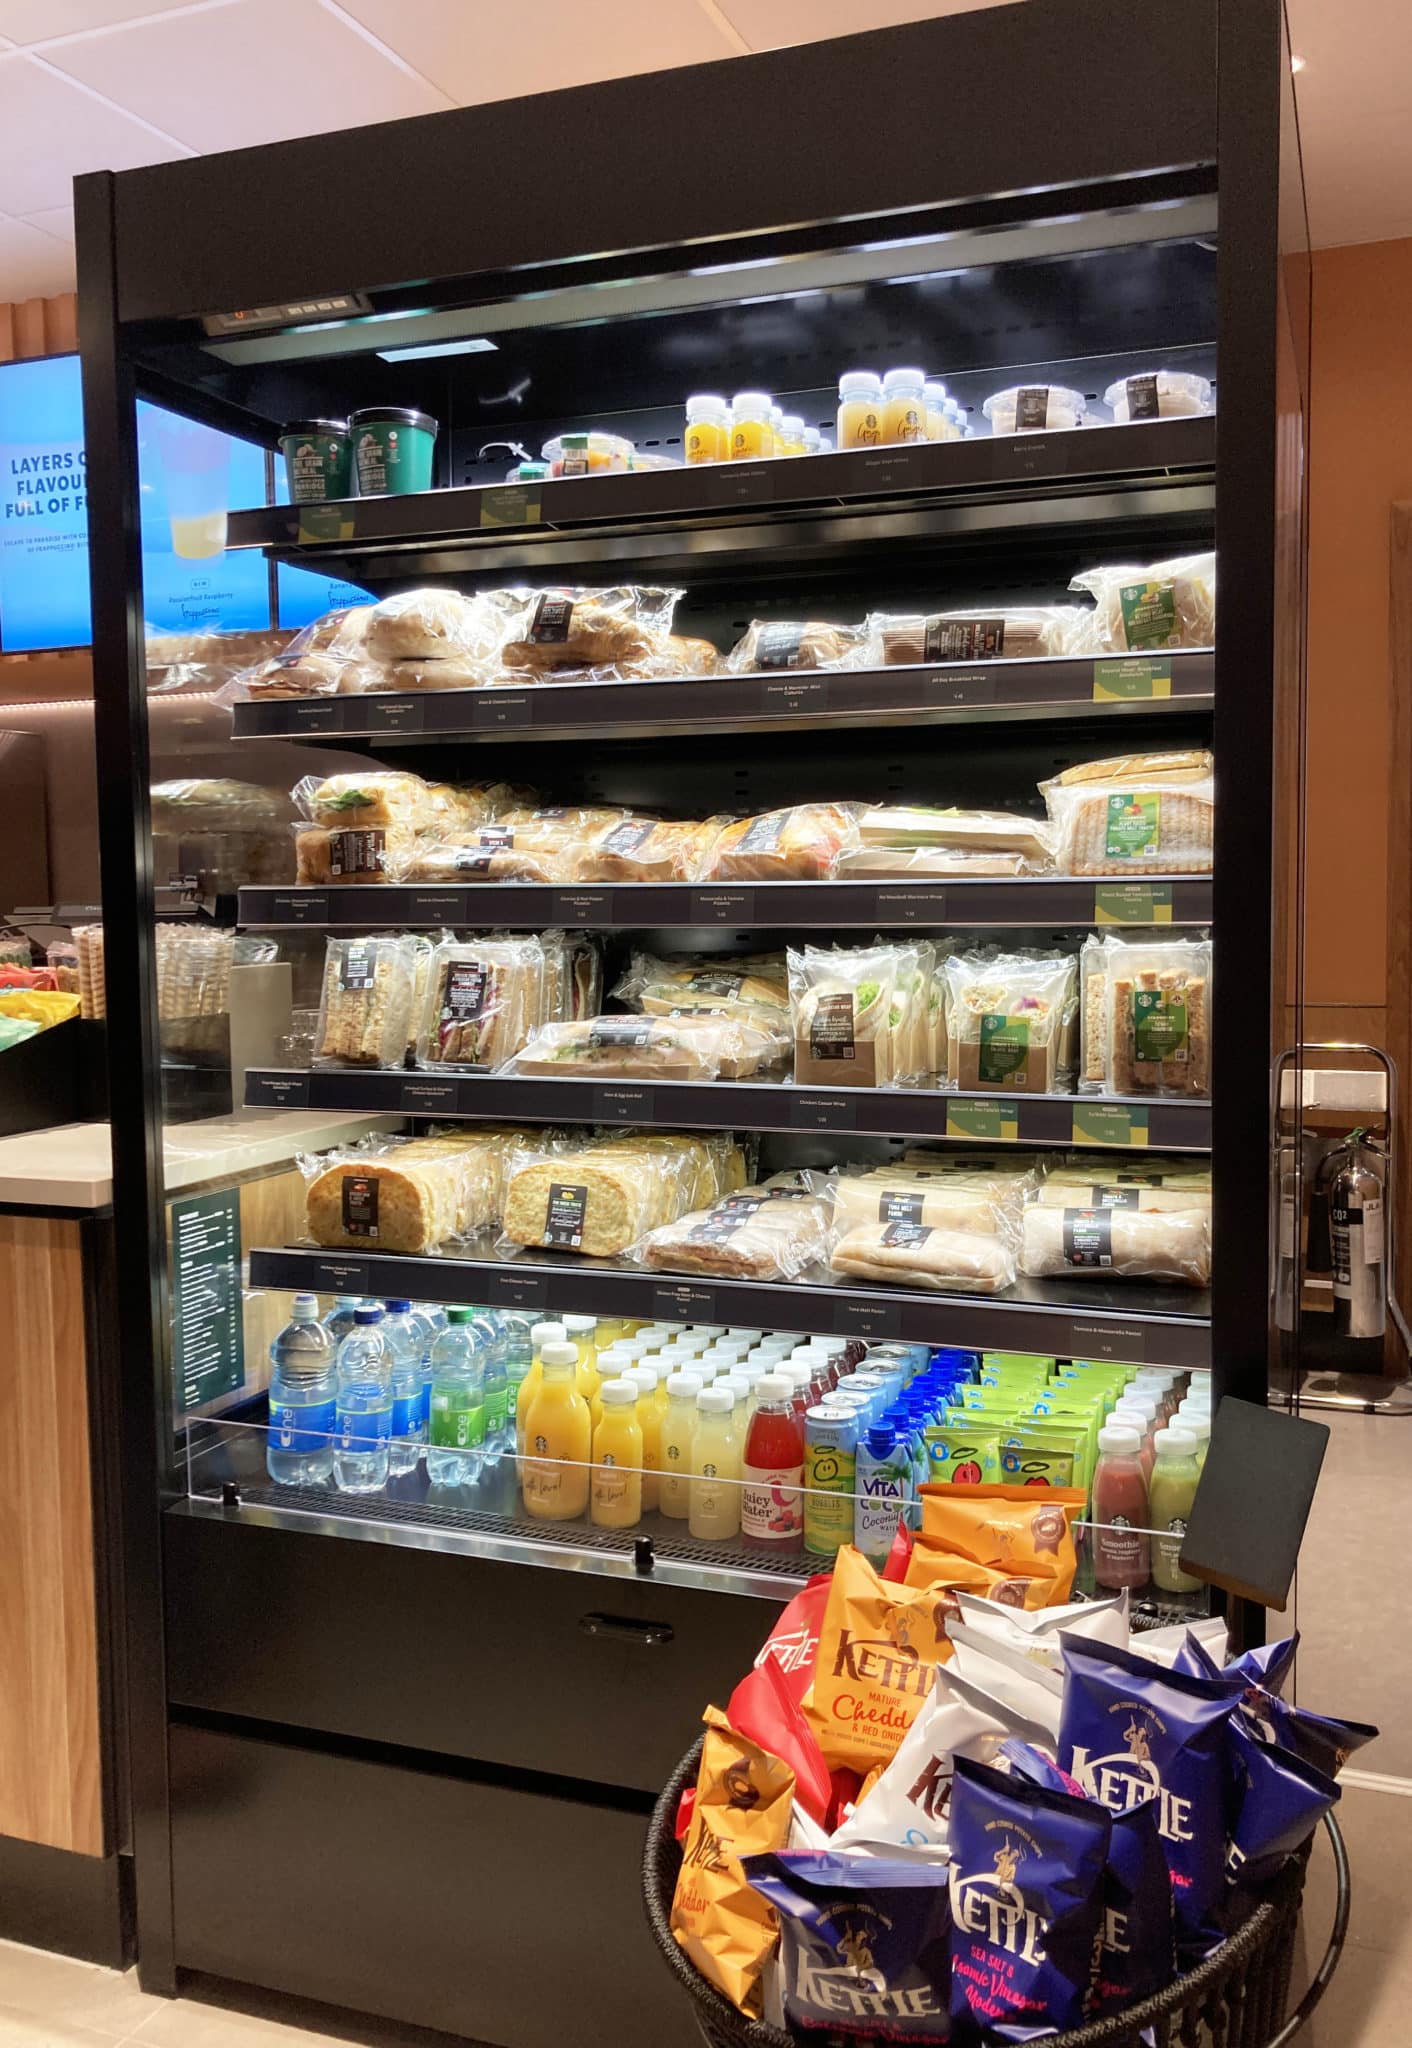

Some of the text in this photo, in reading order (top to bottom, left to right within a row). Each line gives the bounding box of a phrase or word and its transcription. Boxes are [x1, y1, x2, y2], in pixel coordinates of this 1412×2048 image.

[11, 452, 73, 474] LAYERS
[17, 473, 86, 496] FLAVOU
[5, 500, 44, 518] FULL
[48, 496, 69, 514] OF
[863, 1478, 900, 1497] VITA
[832, 1629, 937, 1698] KETTL
[868, 1692, 901, 1706] MATURE
[832, 1694, 914, 1730] Chedd
[852, 1723, 859, 1733] &
[862, 1725, 879, 1737] RED
[1071, 1744, 1194, 1842] KETTLE
[970, 1945, 1015, 1979] SEA SALT &
[795, 1943, 941, 2017] KETTLE
